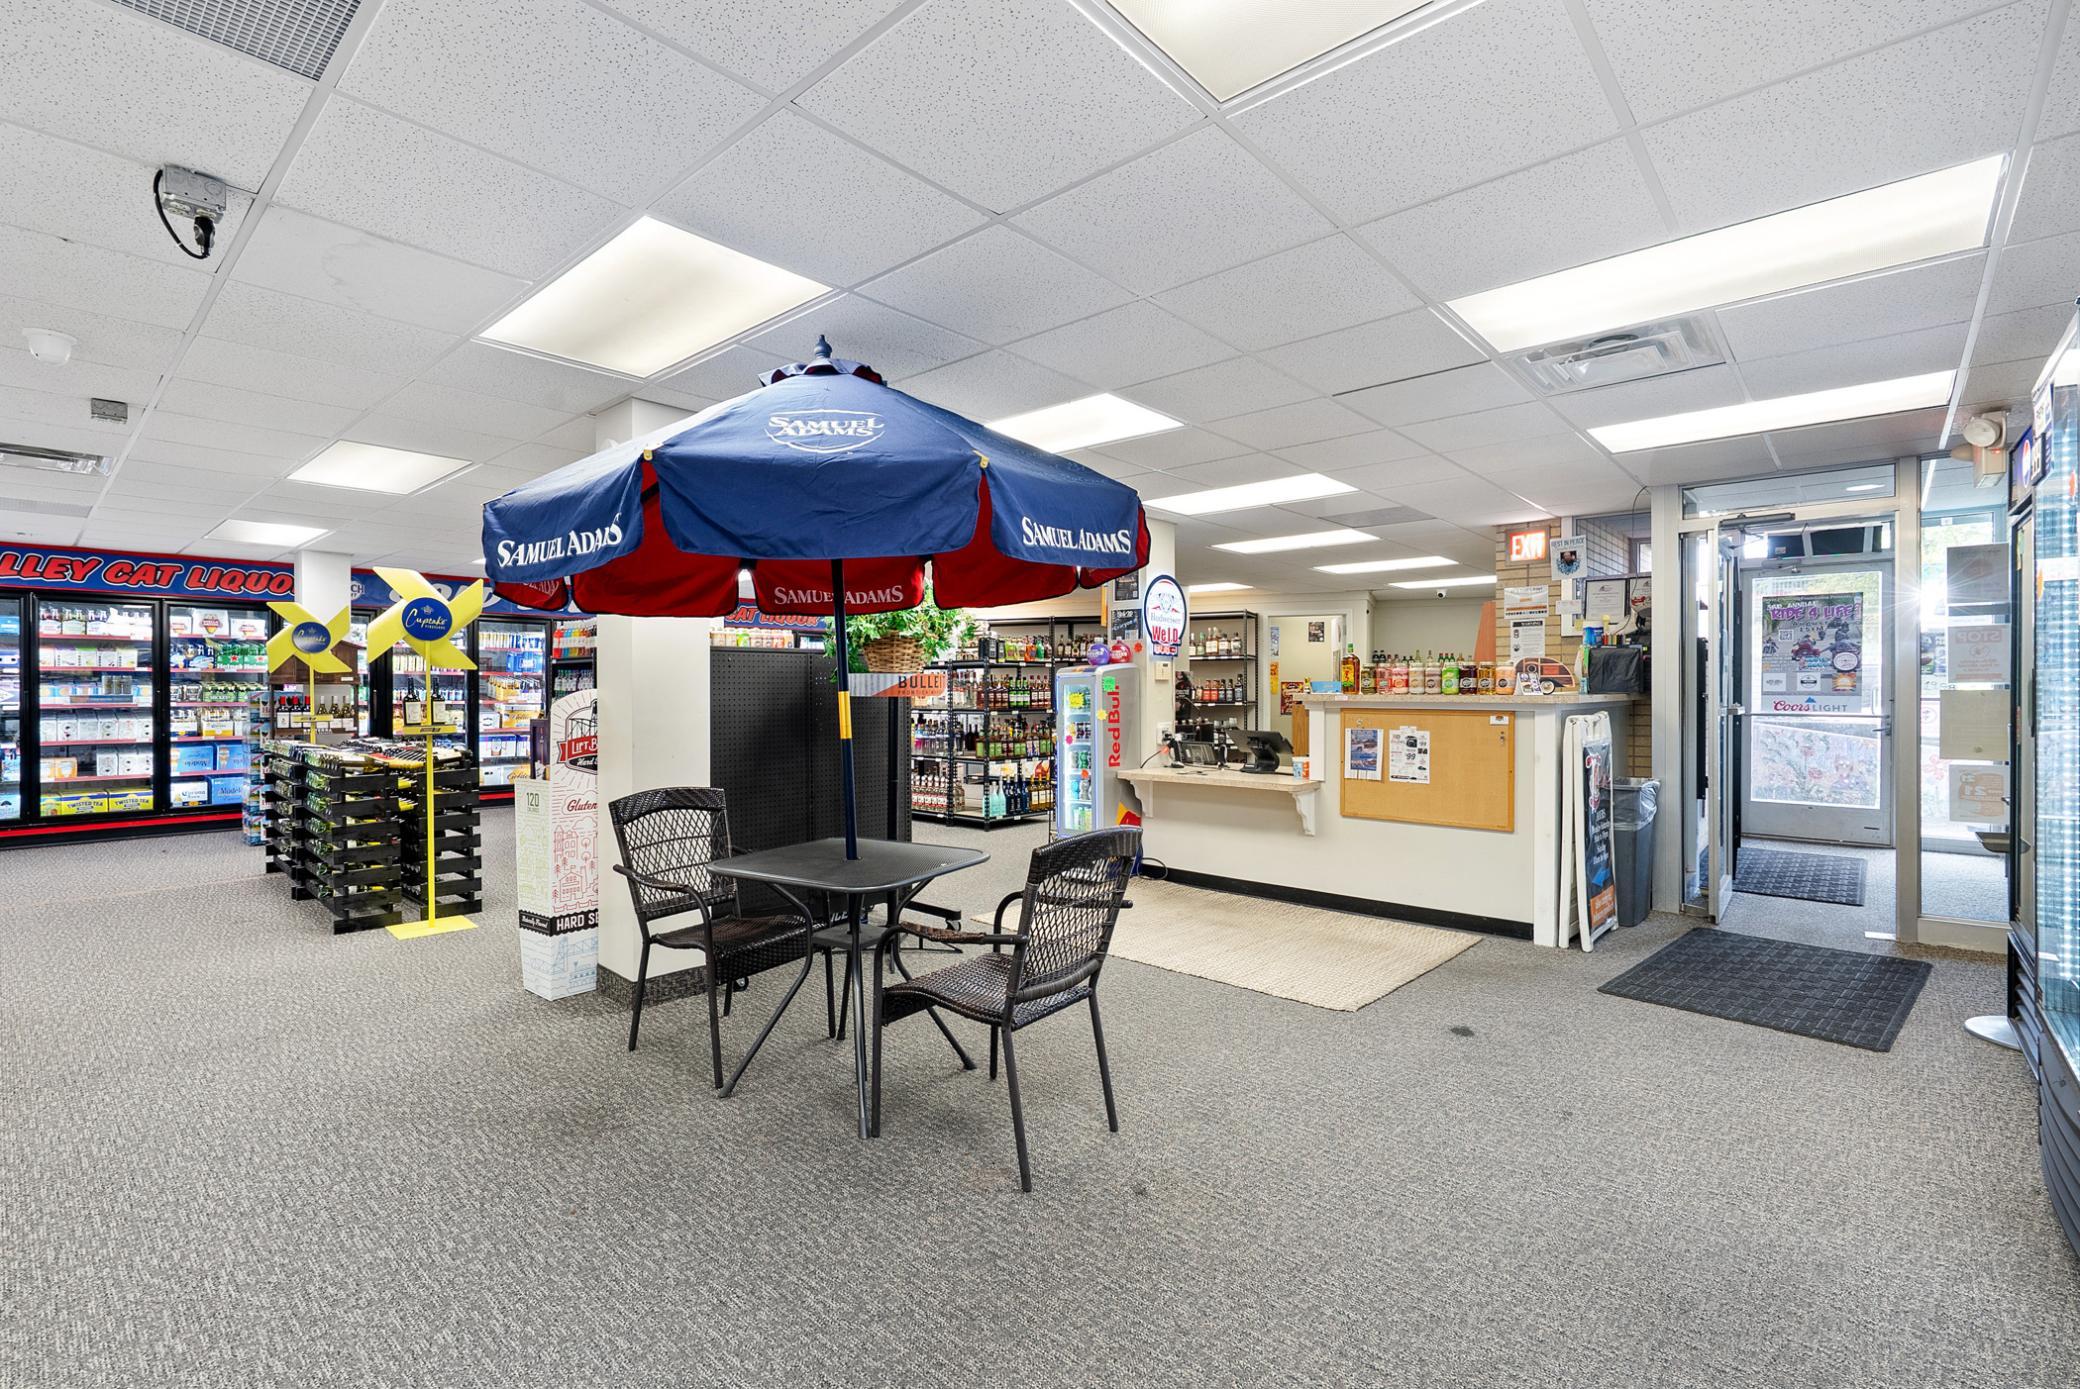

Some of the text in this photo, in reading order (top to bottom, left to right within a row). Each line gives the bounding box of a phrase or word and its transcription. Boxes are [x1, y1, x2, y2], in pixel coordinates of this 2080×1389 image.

[768, 416, 885, 428] SAMUEL
[774, 427, 875, 436] ADAMS
[1021, 516, 1132, 555] SAMUEL ADAMS
[497, 537, 565, 568] SAMUEL
[1511, 532, 1546, 561] EXIT
[102, 560, 184, 588] CAT
[184, 565, 295, 596] LIQUO
[774, 585, 903, 605] SAMUE ADAMS
[405, 608, 448, 629] Cupcake
[1770, 608, 1803, 620] RIDE
[1808, 607, 1818, 619] 4
[1152, 626, 1166, 641] We
[1773, 700, 1848, 712] Coors LIGHT
[571, 741, 588, 755] LIFT
[1108, 728, 1120, 767] Red
[526, 793, 539, 807] 120
[566, 799, 598, 812] Gluten
[556, 913, 584, 931] HARD
